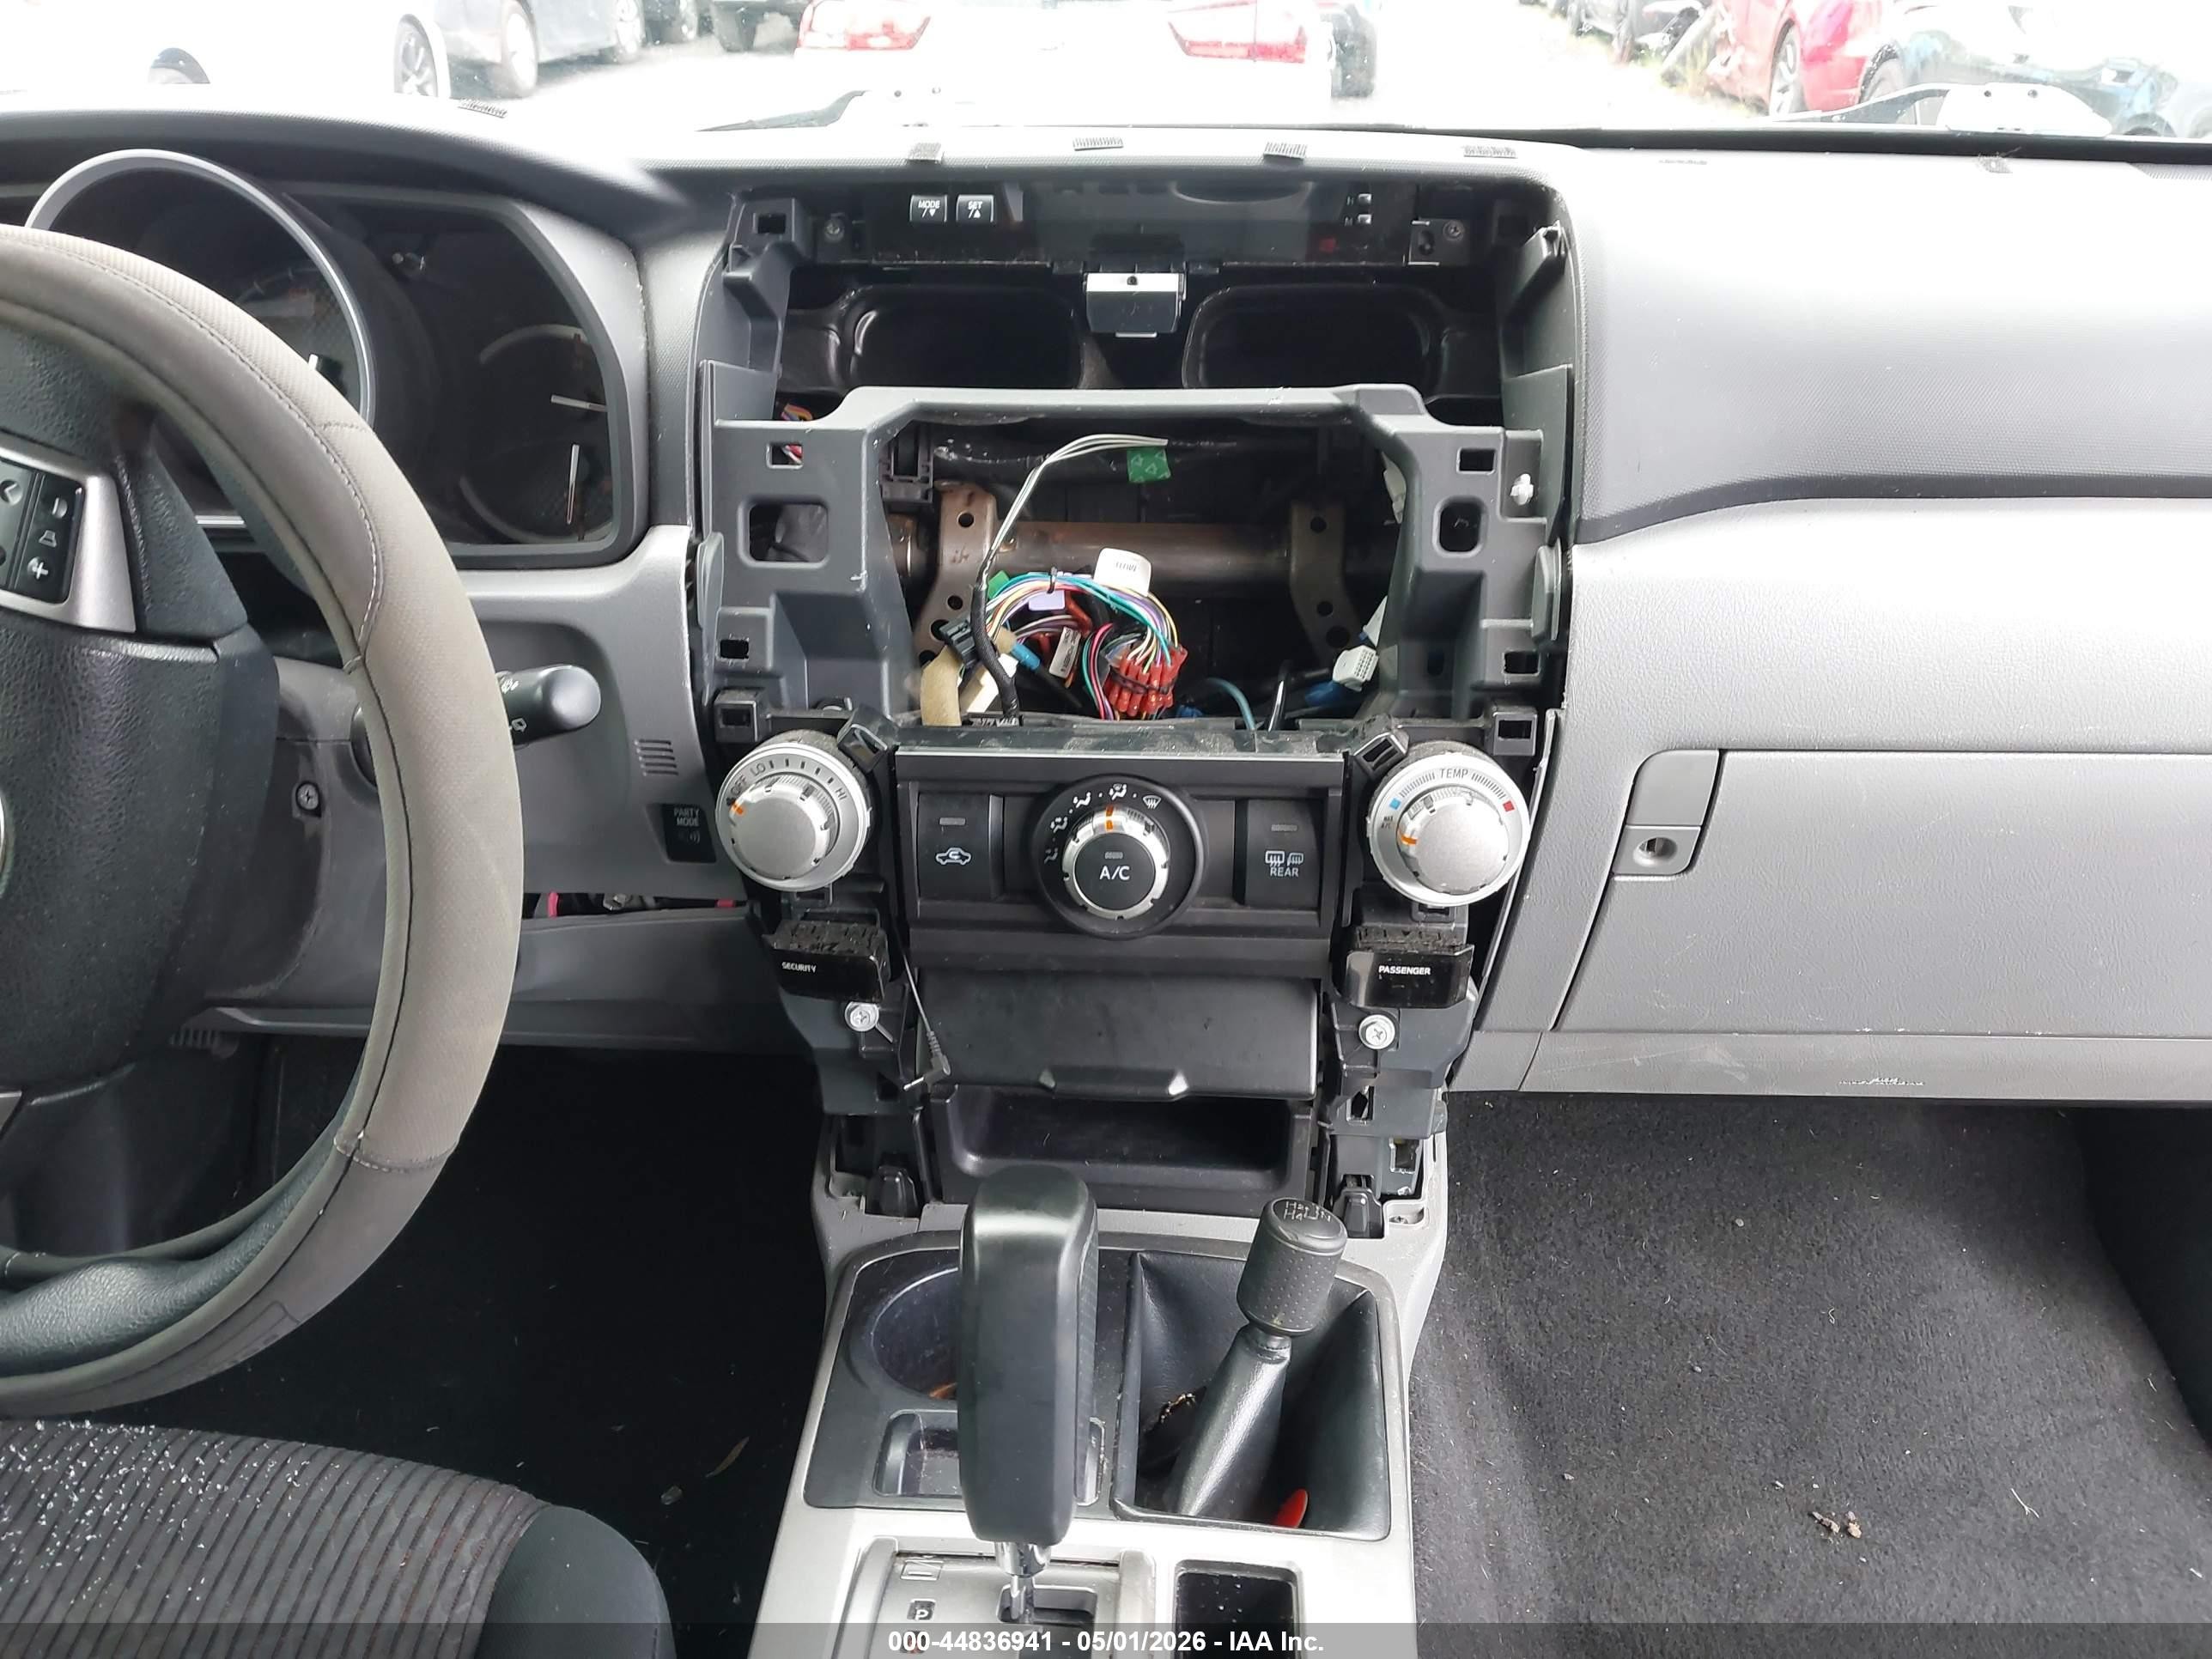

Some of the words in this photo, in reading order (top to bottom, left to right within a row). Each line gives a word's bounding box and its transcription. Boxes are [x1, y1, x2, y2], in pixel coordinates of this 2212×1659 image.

[917, 199, 940, 209] MODE
[968, 200, 983, 210] SET
[750, 762, 766, 776] LO
[1440, 767, 1468, 779] TEMP
[835, 787, 848, 800] HI
[1099, 865, 1130, 880] A/C
[1270, 866, 1299, 878] REAR
[781, 961, 817, 973] SECURITY
[1378, 965, 1431, 975] PASSENGER
[915, 1608, 930, 1622] P
